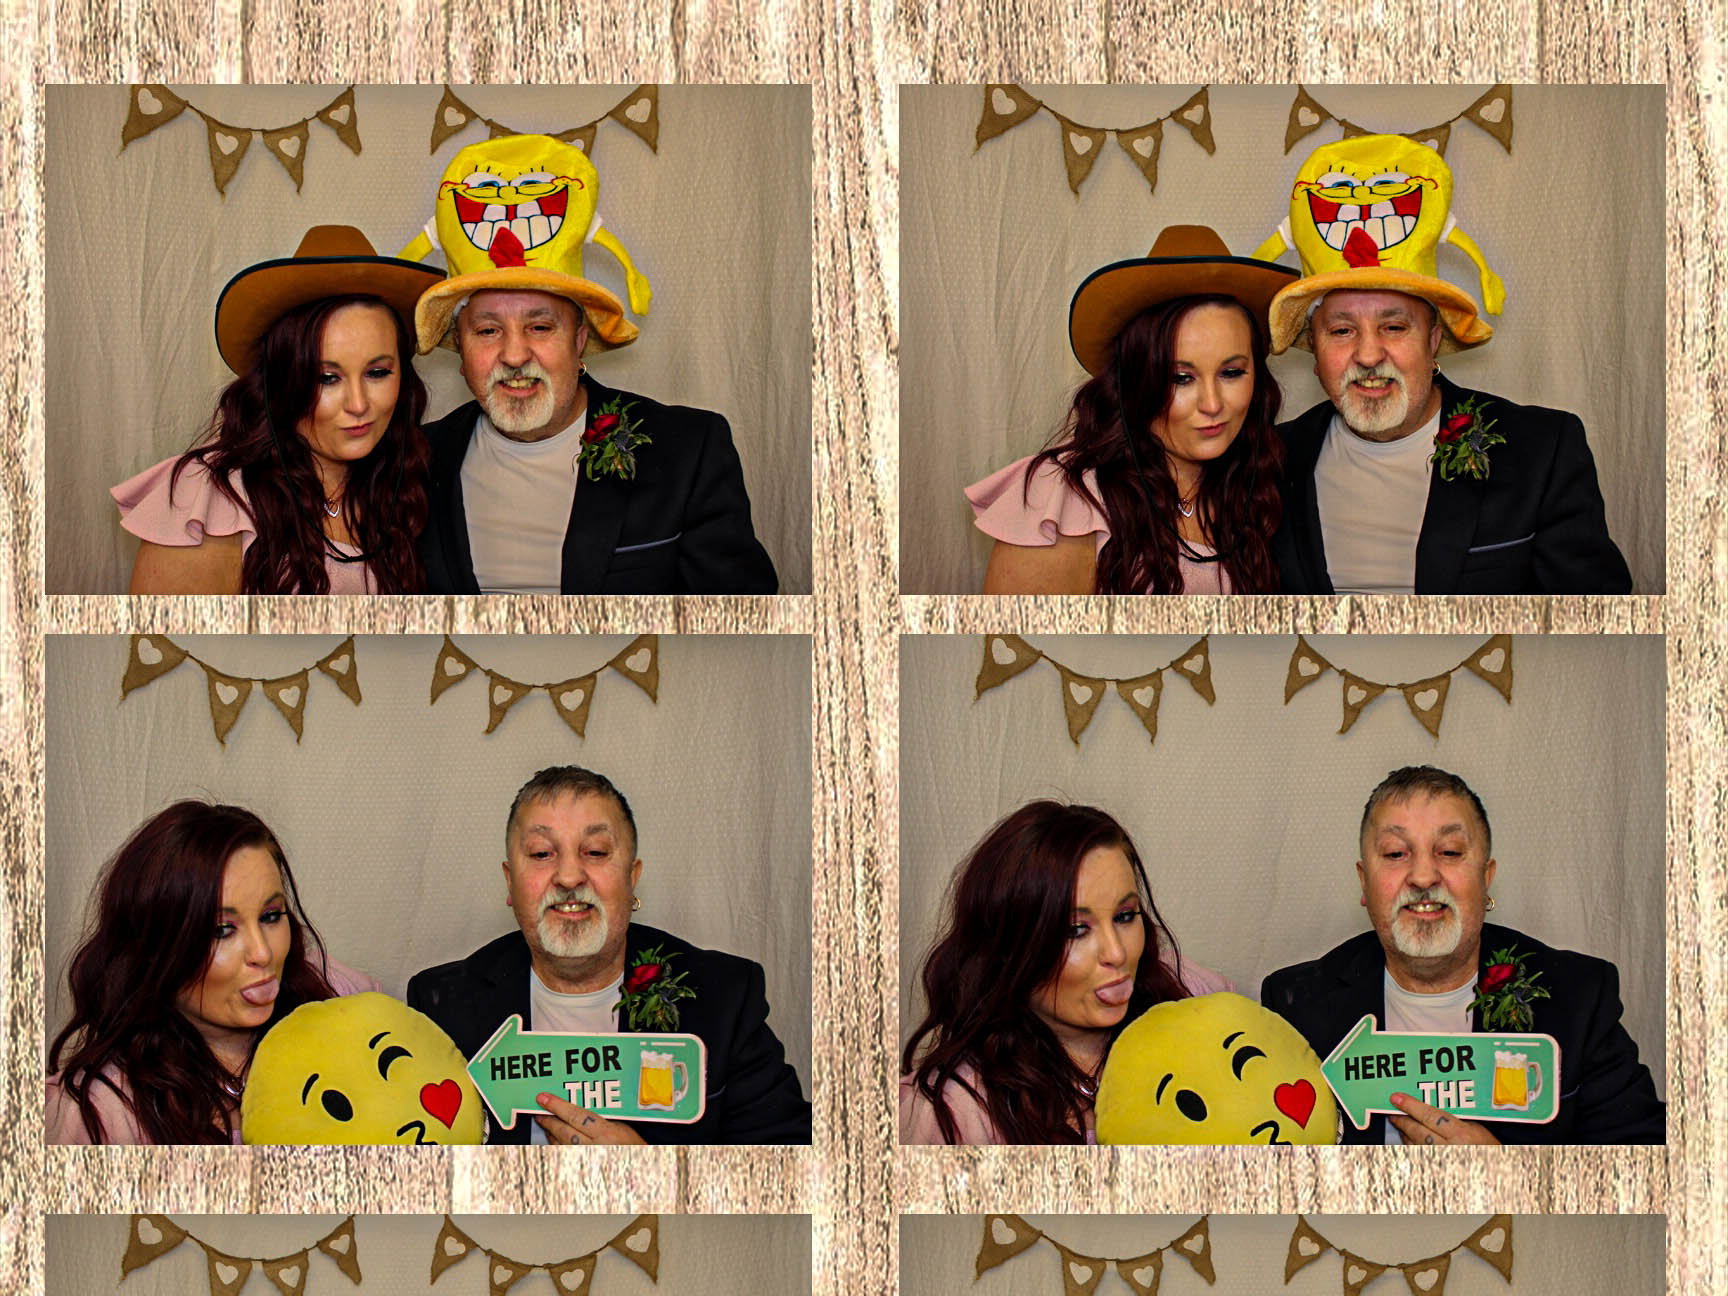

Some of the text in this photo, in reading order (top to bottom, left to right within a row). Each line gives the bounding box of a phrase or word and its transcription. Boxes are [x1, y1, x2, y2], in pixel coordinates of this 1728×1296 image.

[491, 1045, 622, 1081] HERE FOR
[1345, 1045, 1476, 1081] HERE FOR
[563, 1080, 622, 1109] THE
[1417, 1080, 1476, 1109] THE
